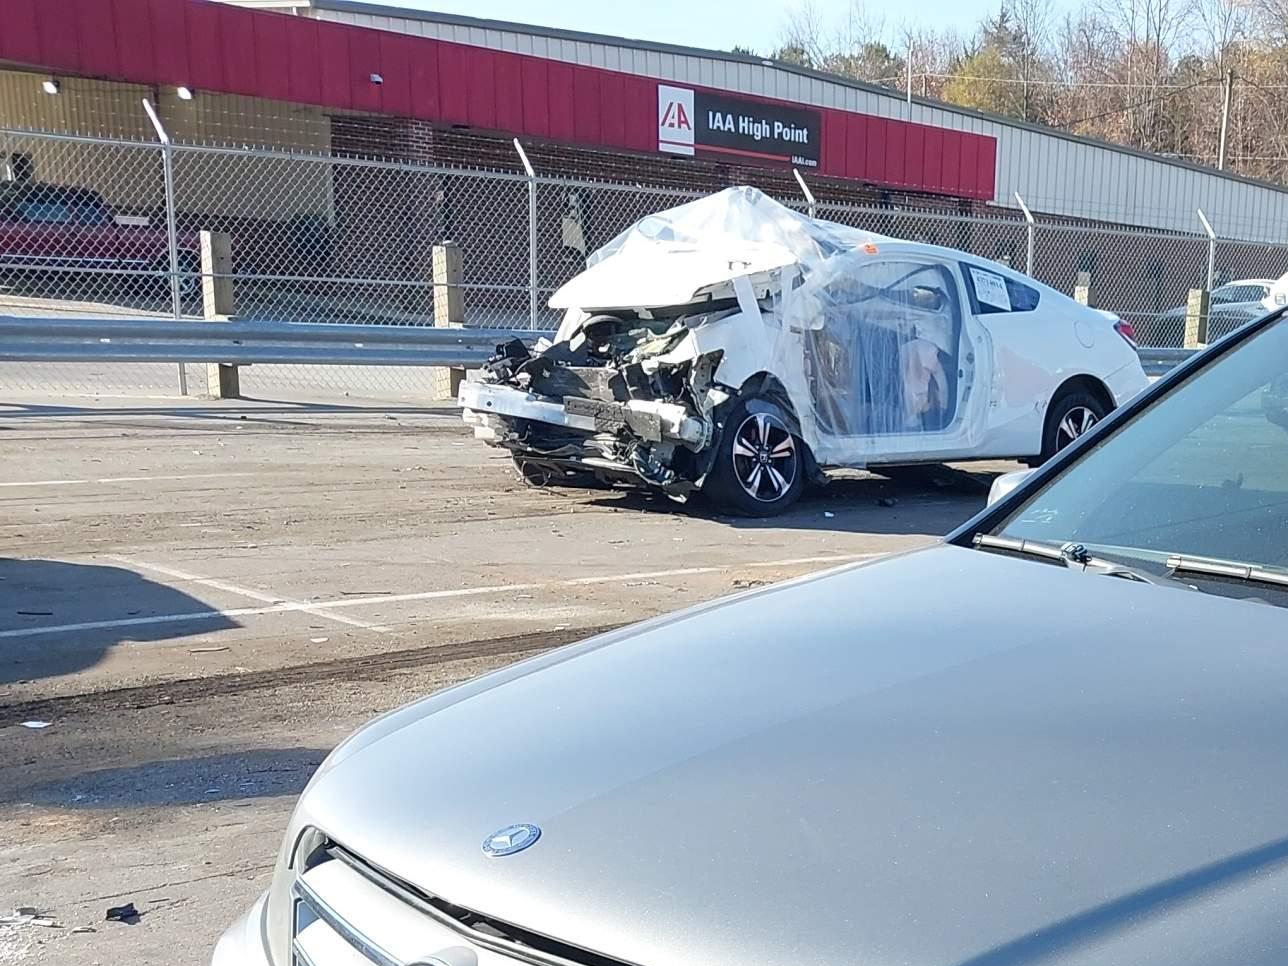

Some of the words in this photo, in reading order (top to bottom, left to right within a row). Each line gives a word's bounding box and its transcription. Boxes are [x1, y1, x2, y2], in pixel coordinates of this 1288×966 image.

[708, 110, 735, 133] IAA
[738, 115, 770, 141] High
[774, 121, 809, 144] Point
